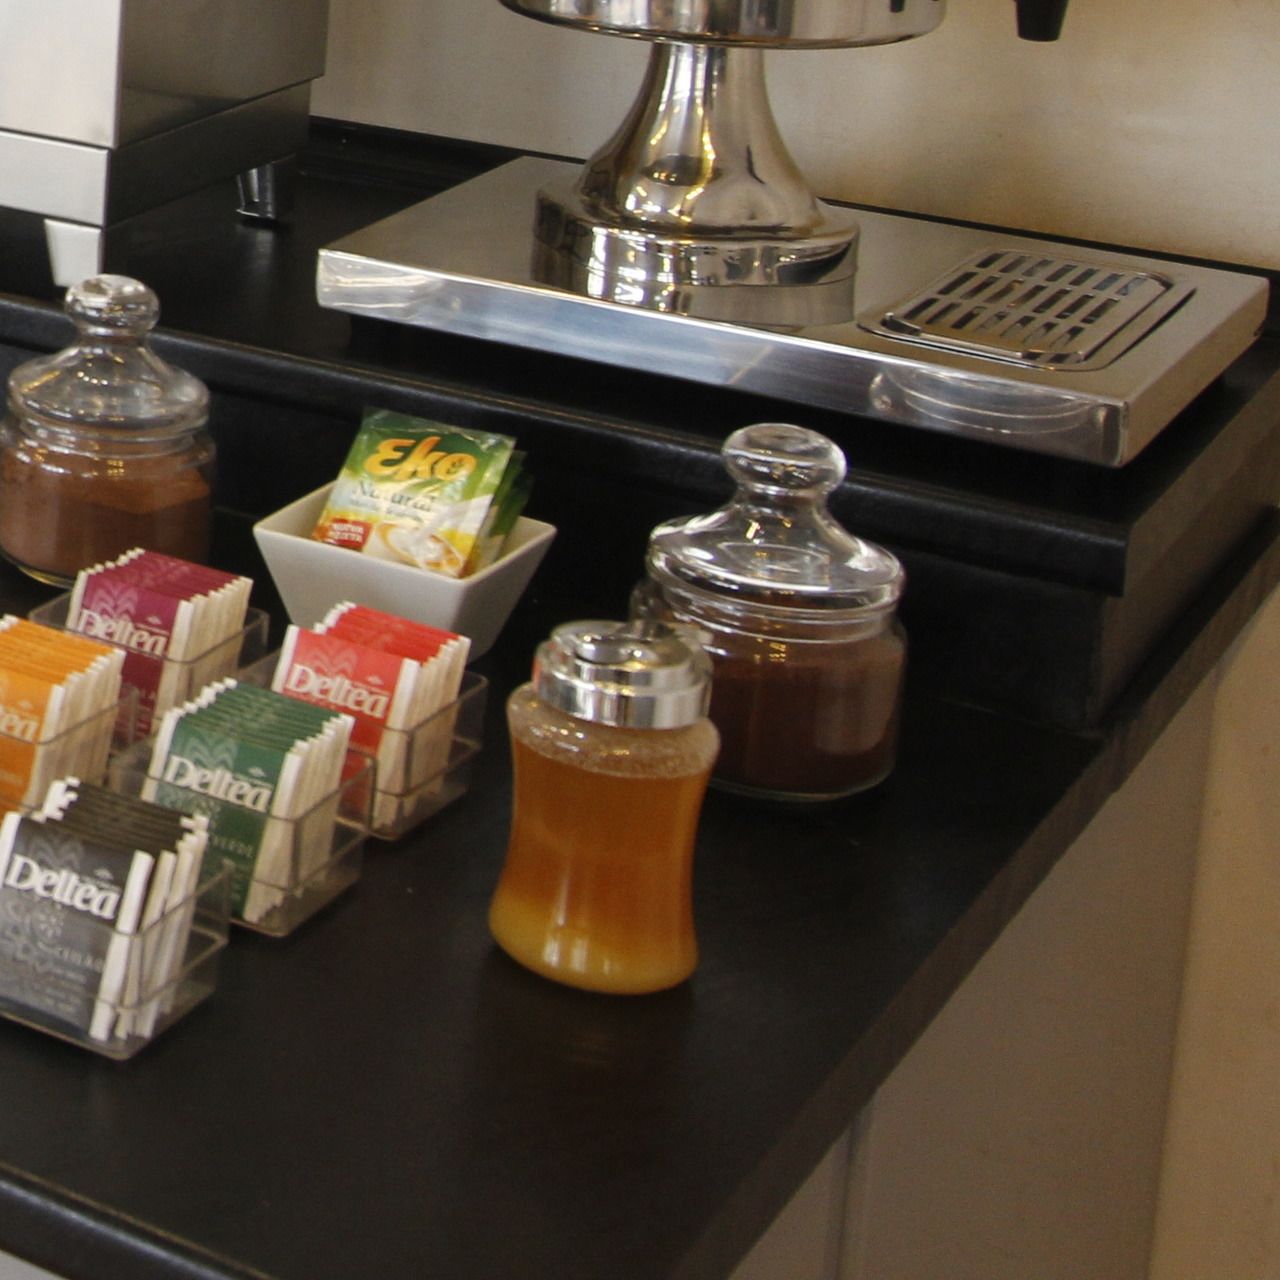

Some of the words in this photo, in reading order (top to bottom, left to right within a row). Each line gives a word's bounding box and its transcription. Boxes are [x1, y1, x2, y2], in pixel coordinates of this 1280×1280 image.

[363, 435, 477, 481] Eko
[352, 479, 437, 512] Naural
[76, 608, 169, 656] Deltea
[286, 663, 390, 719] Deltea
[162, 754, 273, 813] Deltea
[4, 853, 121, 920] Deltea
